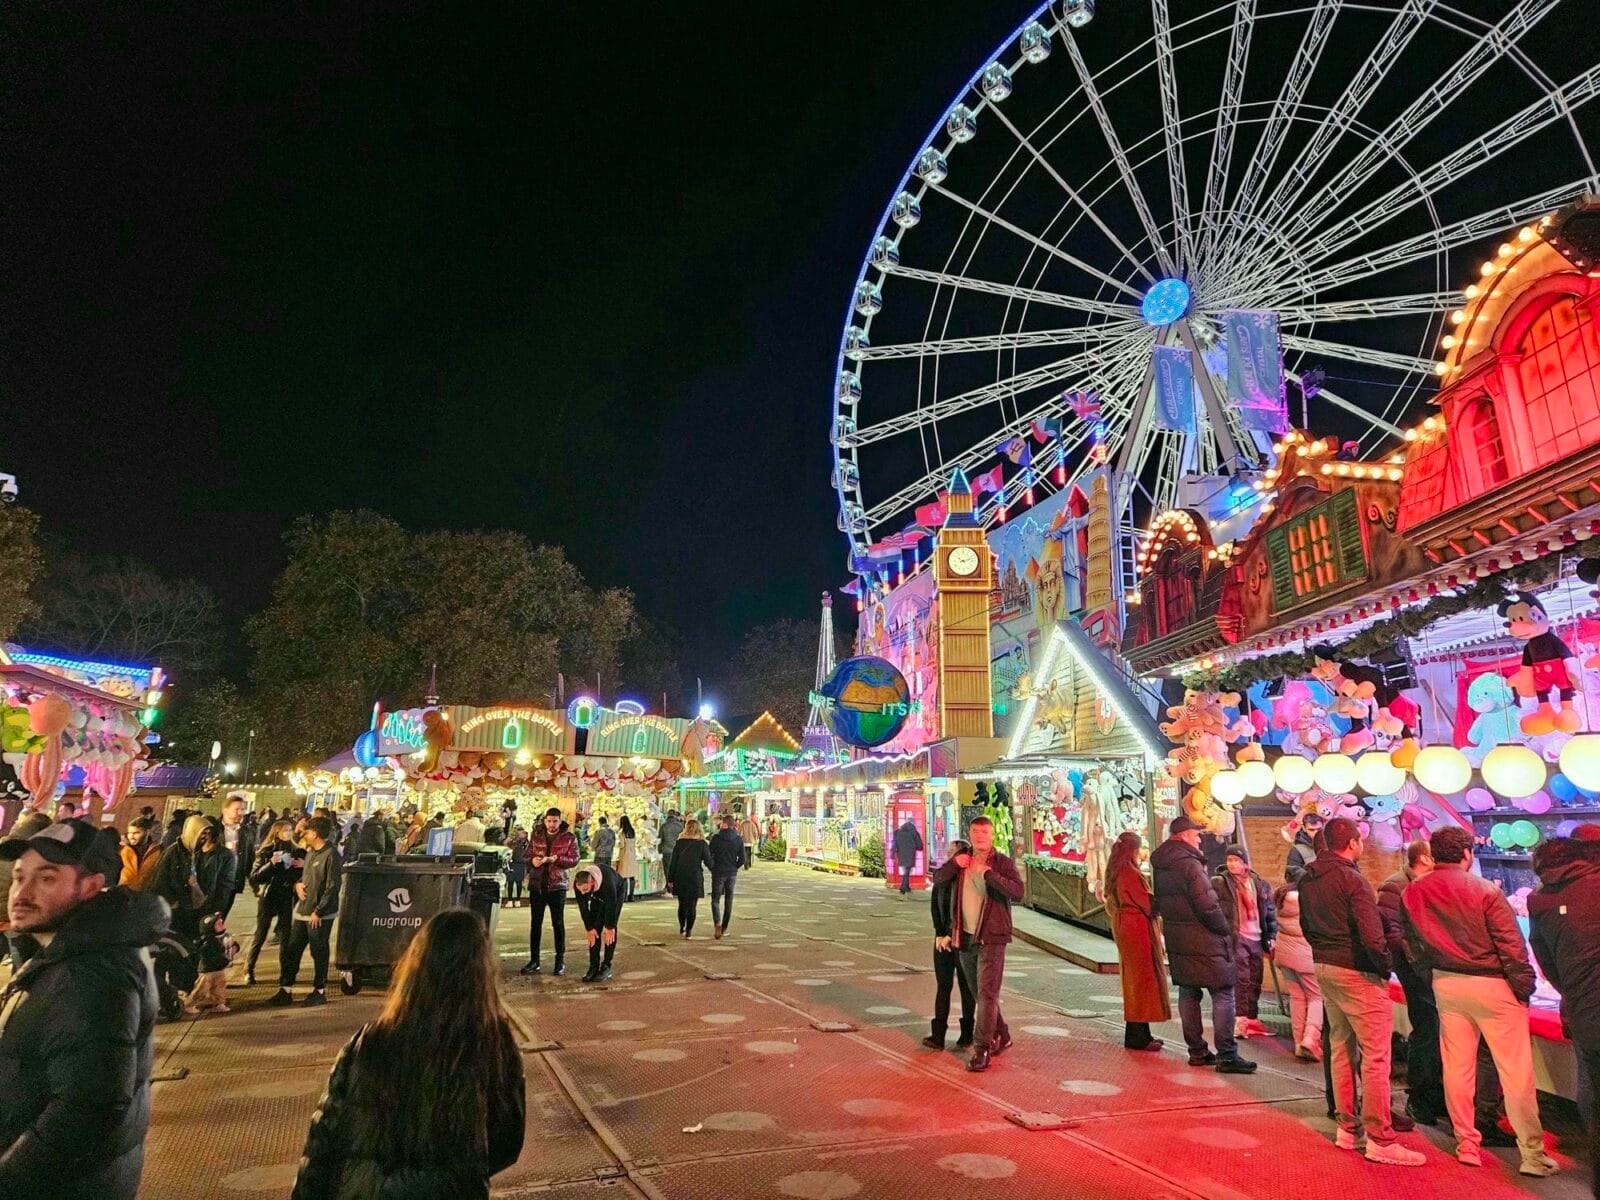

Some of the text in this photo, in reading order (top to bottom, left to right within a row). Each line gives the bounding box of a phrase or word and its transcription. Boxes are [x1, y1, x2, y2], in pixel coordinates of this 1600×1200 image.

[461, 709, 563, 736] RING OVER THE BOTTLE
[600, 716, 679, 743] RING OVER THE BOTTLE
[372, 917, 422, 928] nugroup
